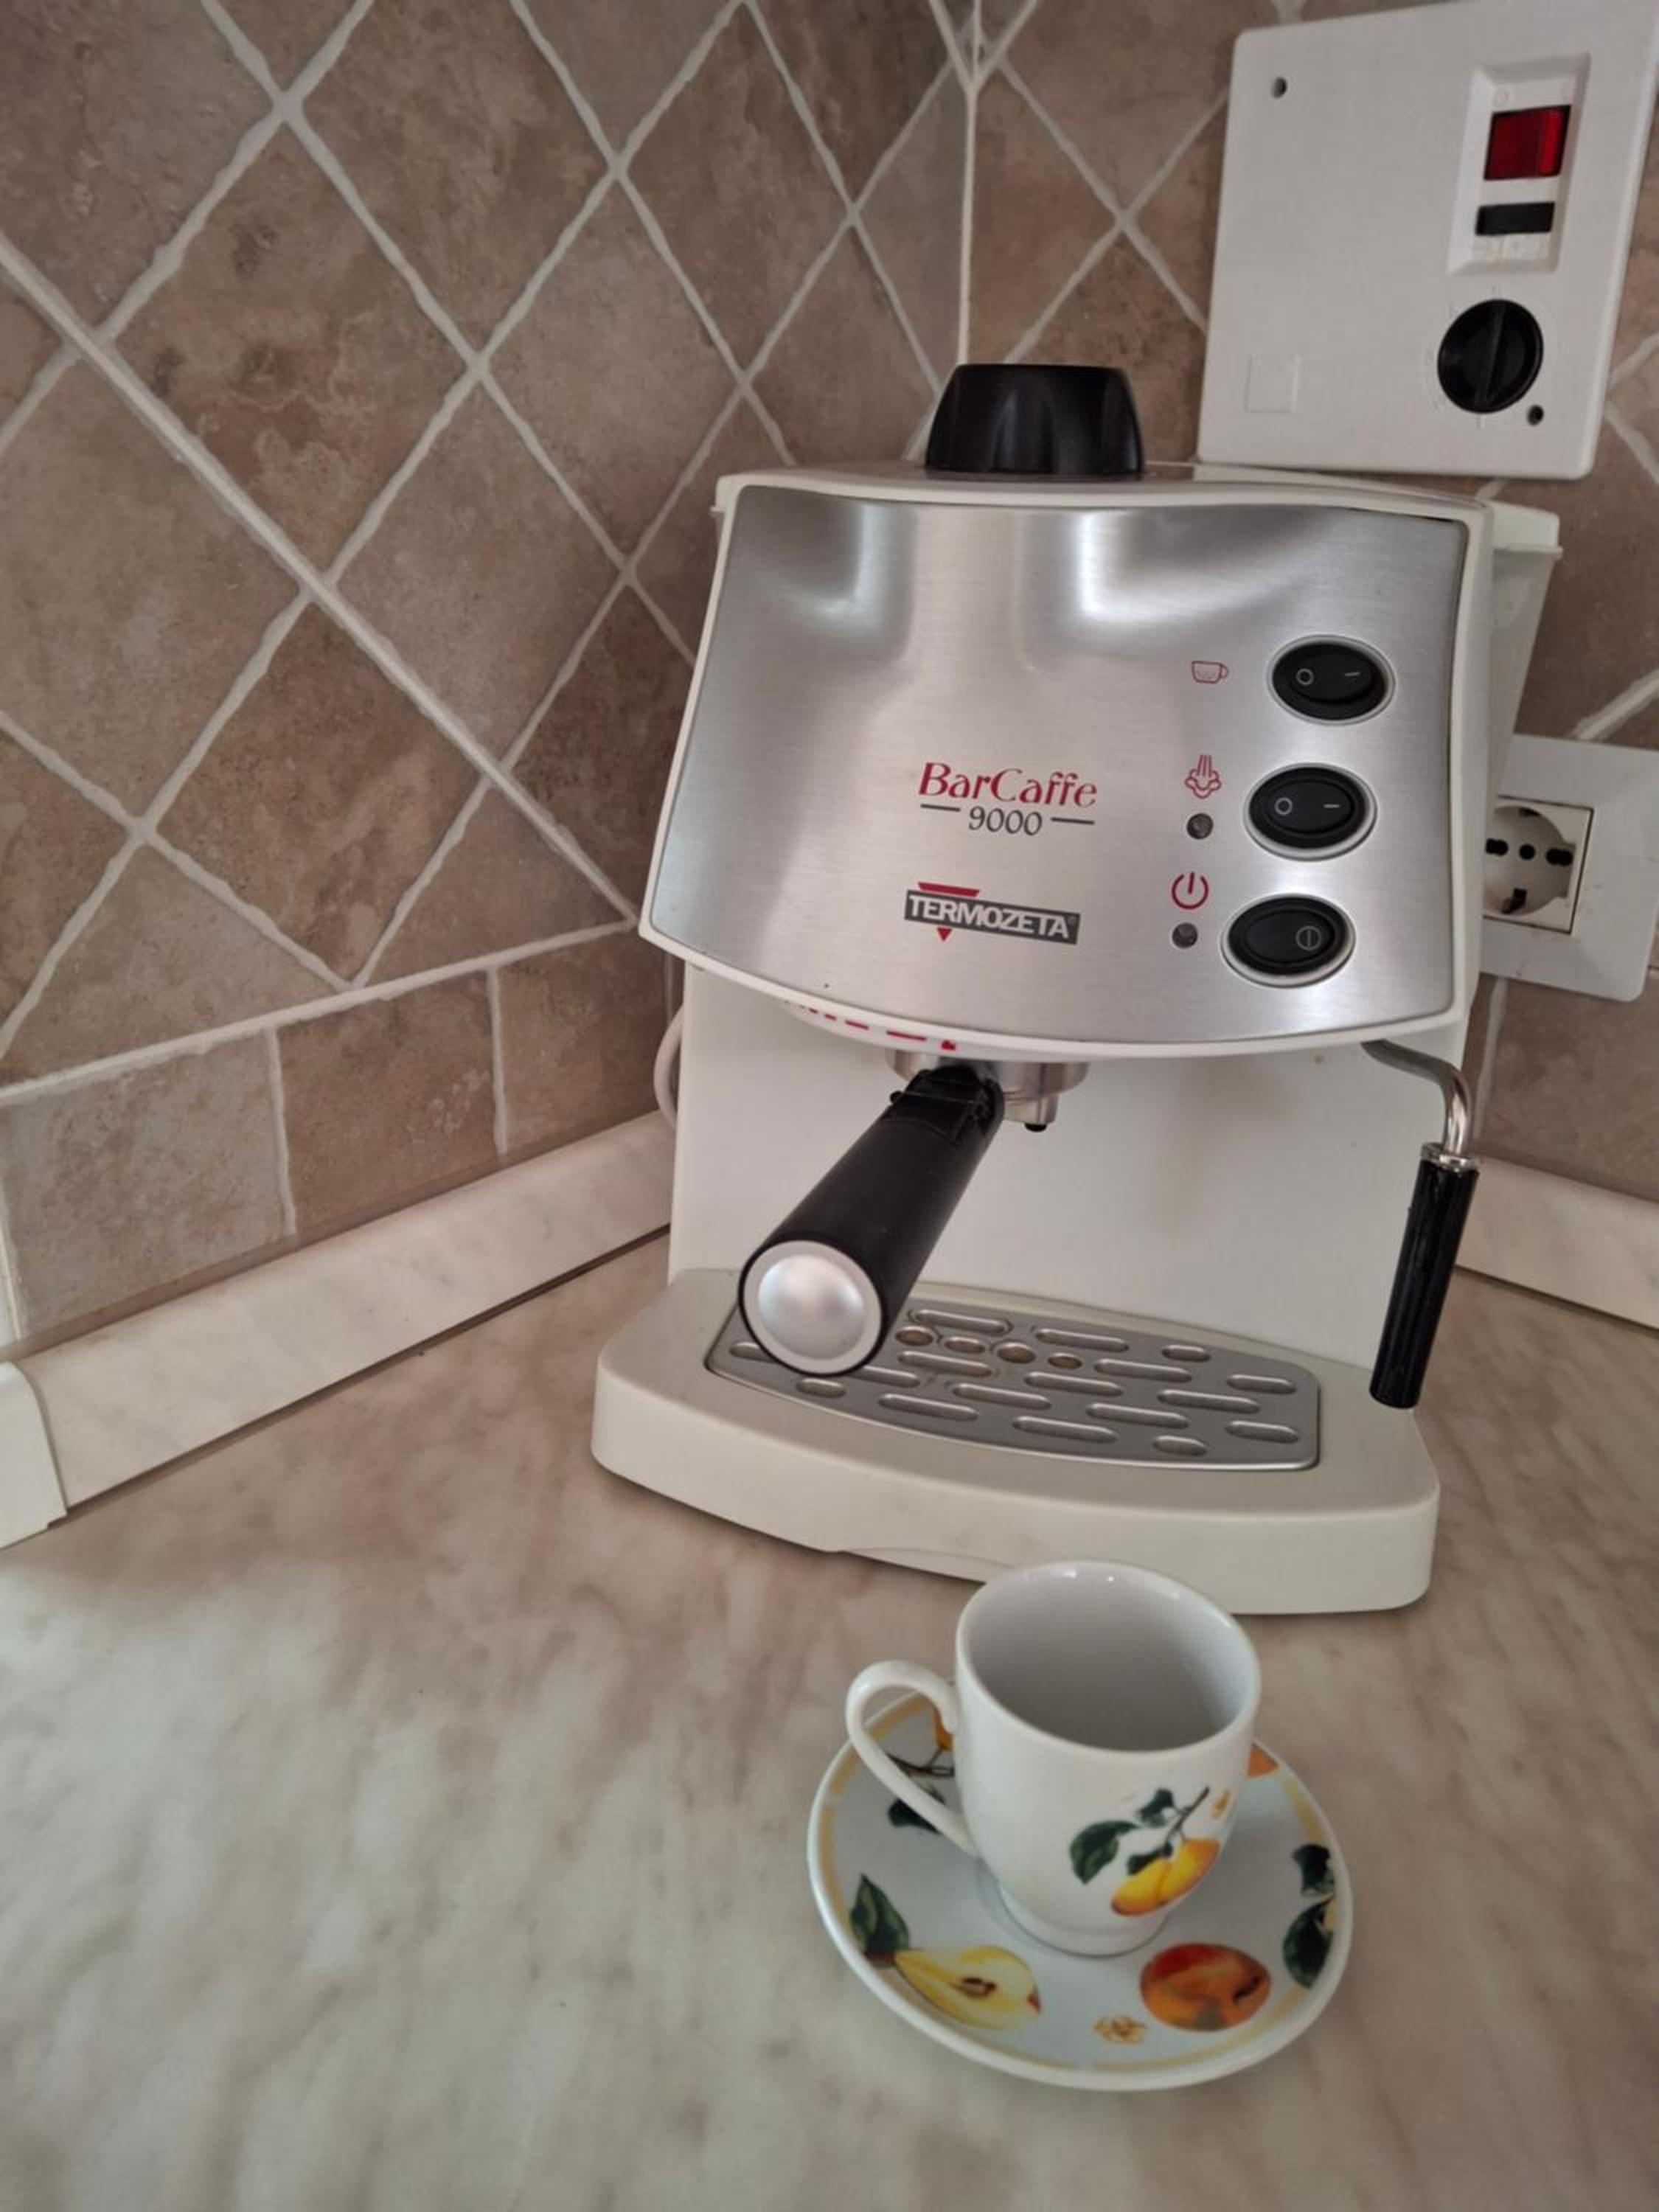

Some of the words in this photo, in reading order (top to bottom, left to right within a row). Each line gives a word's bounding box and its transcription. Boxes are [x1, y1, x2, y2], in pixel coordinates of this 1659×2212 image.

[919, 762, 1097, 807] BarCaffe
[968, 805, 1043, 836] 9000
[908, 894, 1071, 939] TERMOZETA
